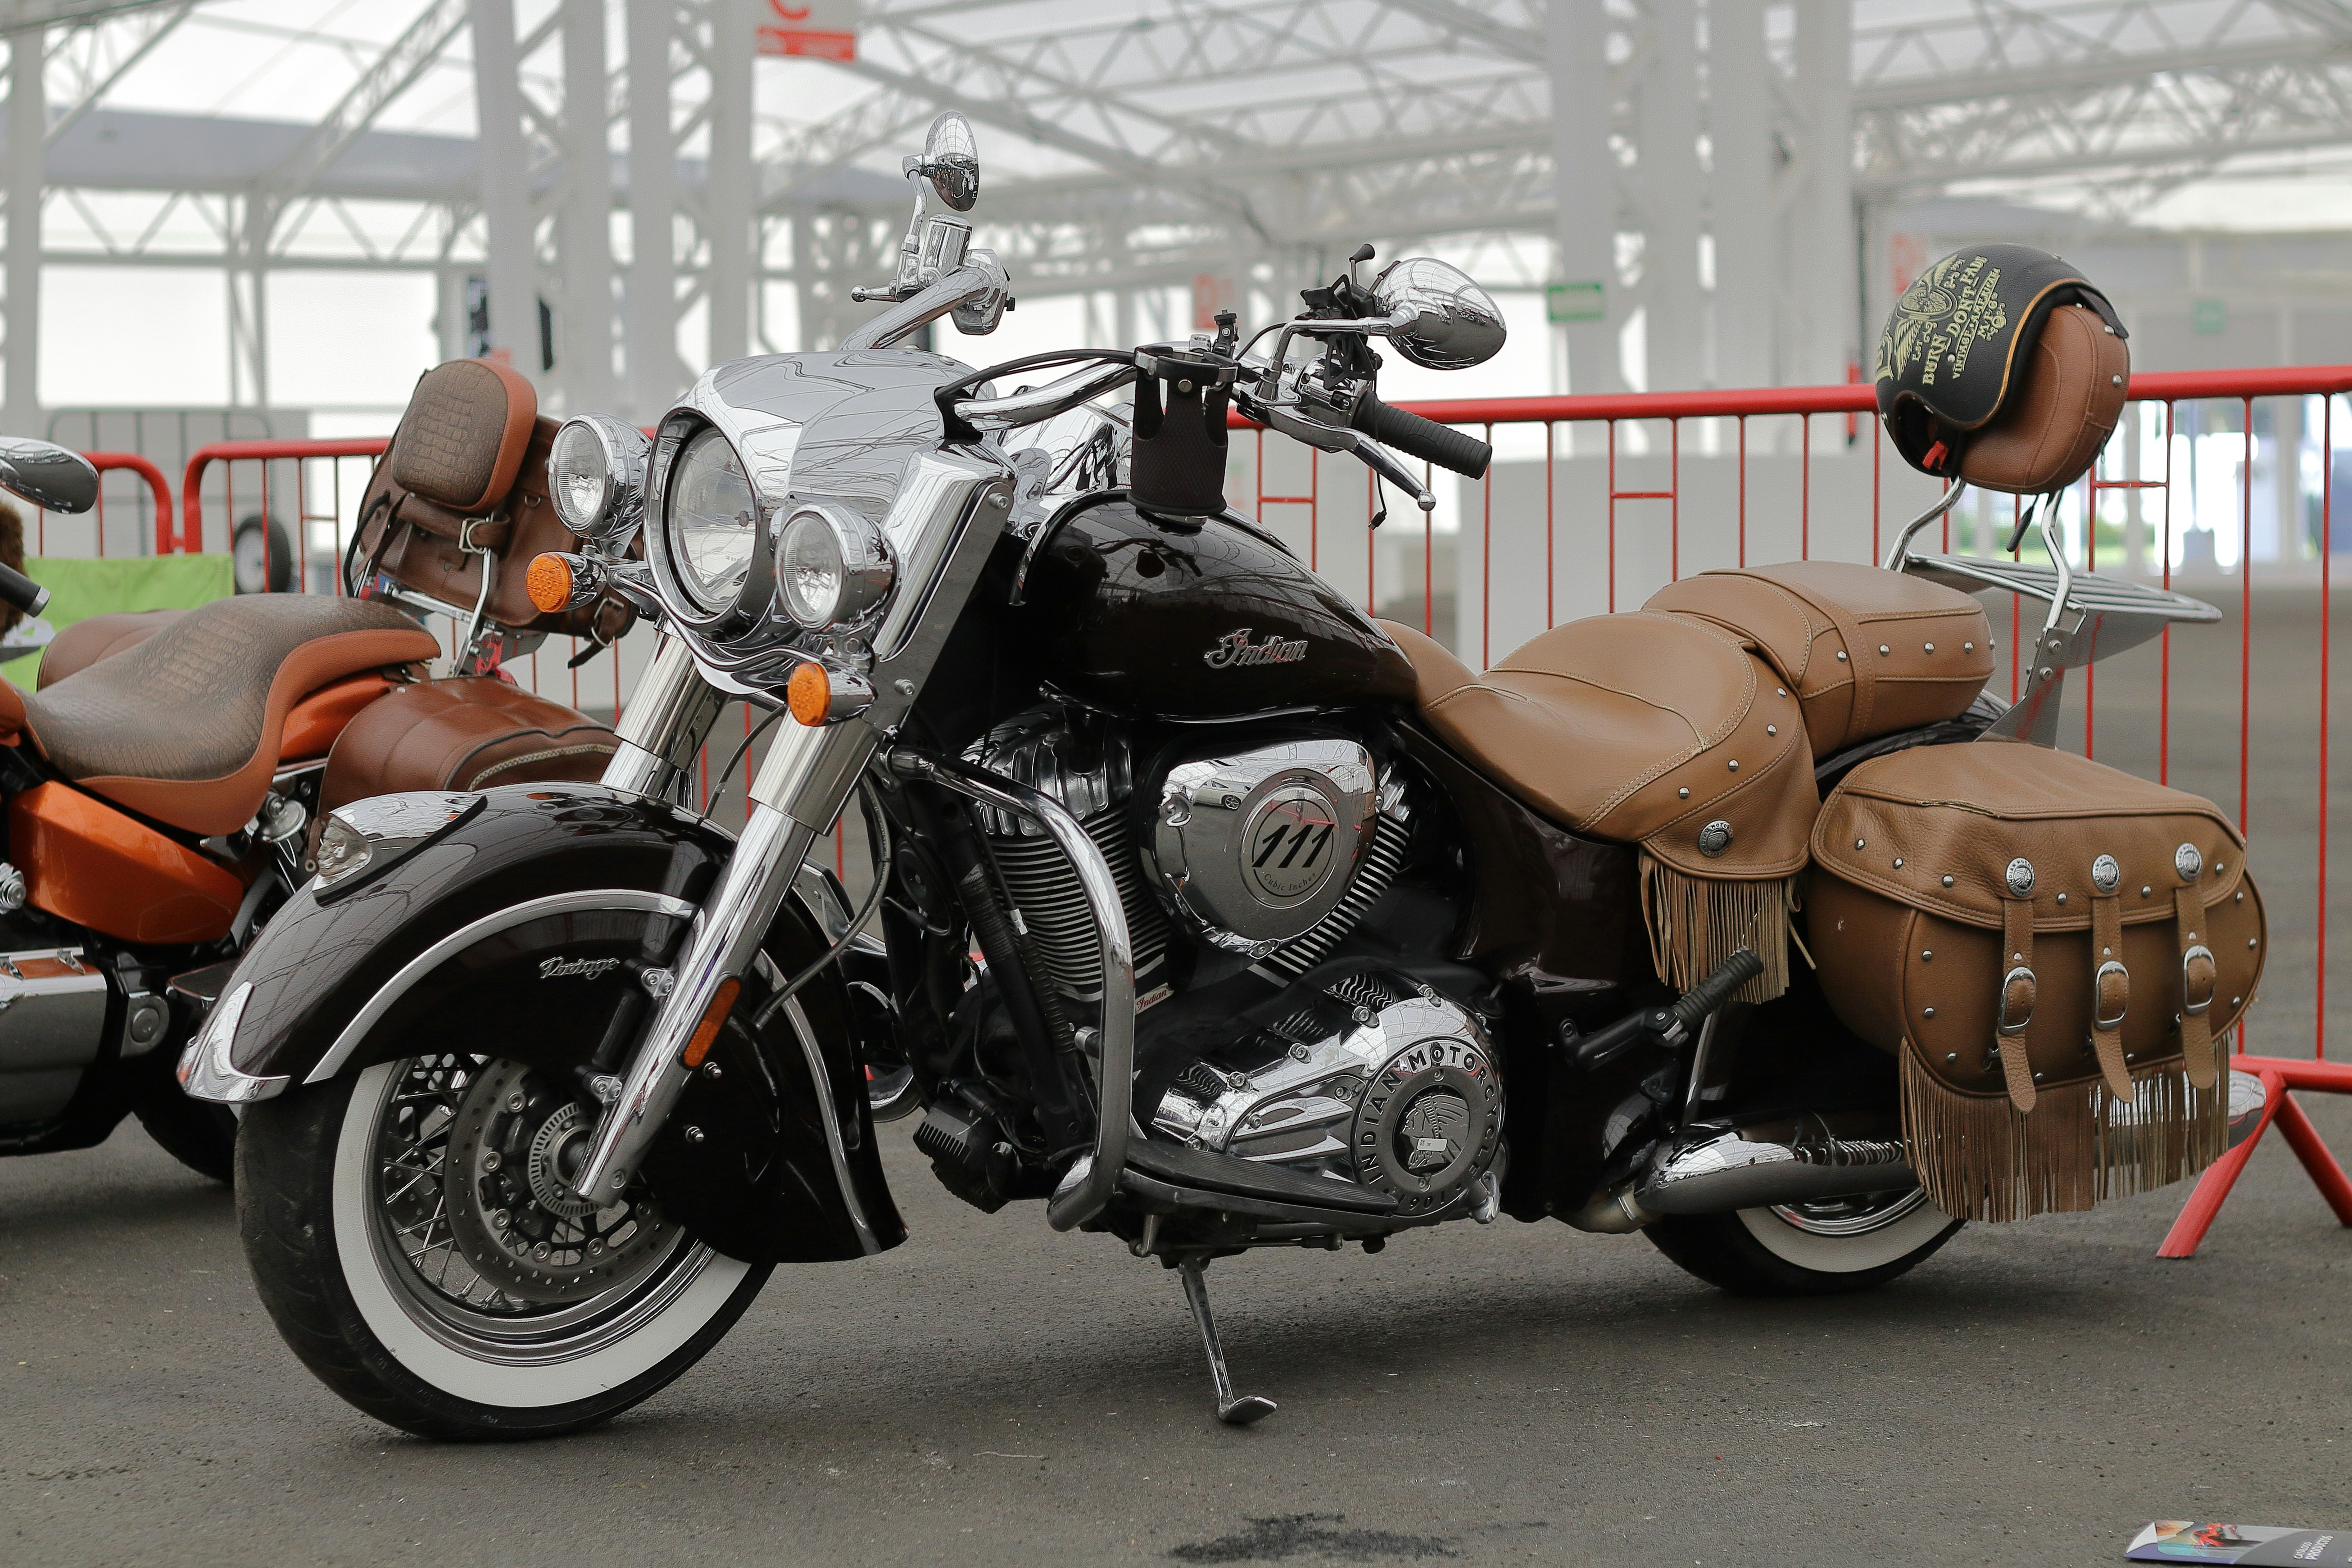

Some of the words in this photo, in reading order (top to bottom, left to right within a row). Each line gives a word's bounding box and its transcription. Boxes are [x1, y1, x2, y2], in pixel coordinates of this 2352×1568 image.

[1922, 333, 1949, 385] BURN
[1960, 255, 1989, 285] FADE
[1953, 329, 1972, 379] VINTAGE
[1203, 628, 1309, 669] Indian
[1252, 823, 1336, 869] 111
[1264, 874, 1285, 891] Cubic
[1288, 872, 1316, 891] Inches
[1136, 989, 1167, 1011] Indian
[1360, 1071, 1403, 1185] INDIAN
[1406, 1045, 1498, 1179] MOTORCYCLE
[1397, 1190, 1445, 1211] 1901
[2305, 1535, 2334, 1561] PRODUCTOS
